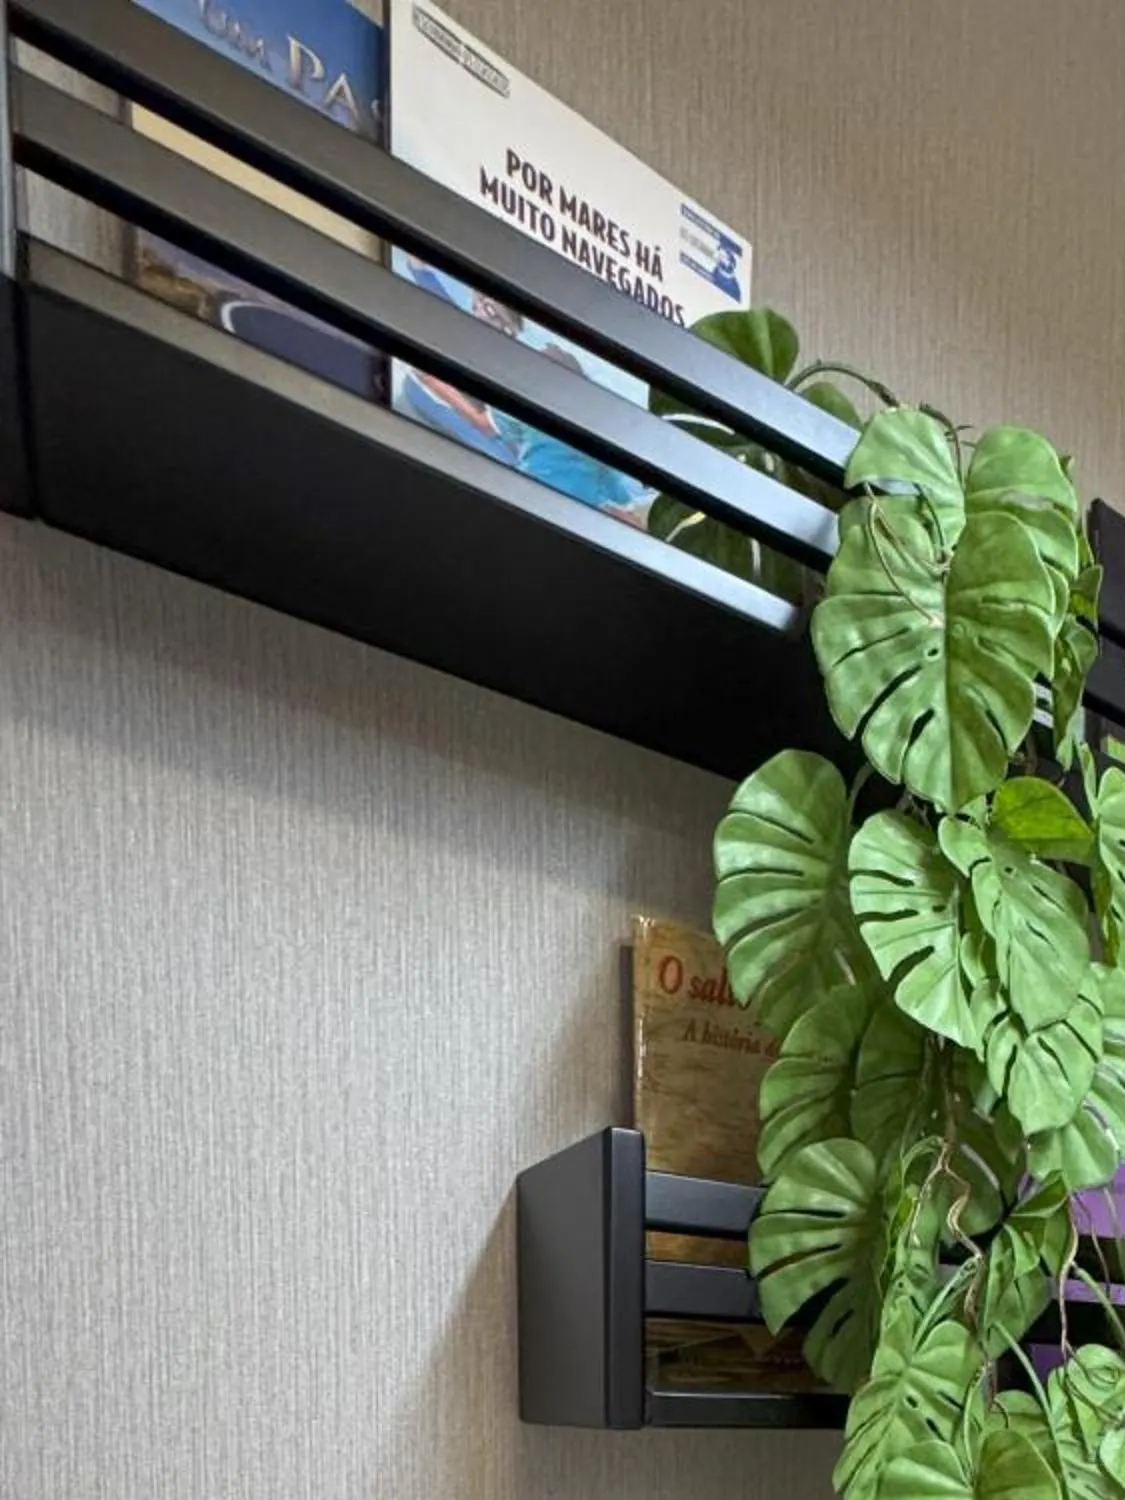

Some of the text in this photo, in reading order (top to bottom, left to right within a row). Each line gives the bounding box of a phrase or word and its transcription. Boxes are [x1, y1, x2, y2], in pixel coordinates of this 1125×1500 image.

[479, 165, 686, 329] MUITO NAVEGADOS
[506, 147, 553, 207] POR
[559, 186, 631, 258] MARES
[635, 240, 664, 283] HÁ
[658, 955, 684, 995] O
[682, 1018, 697, 1042] A
